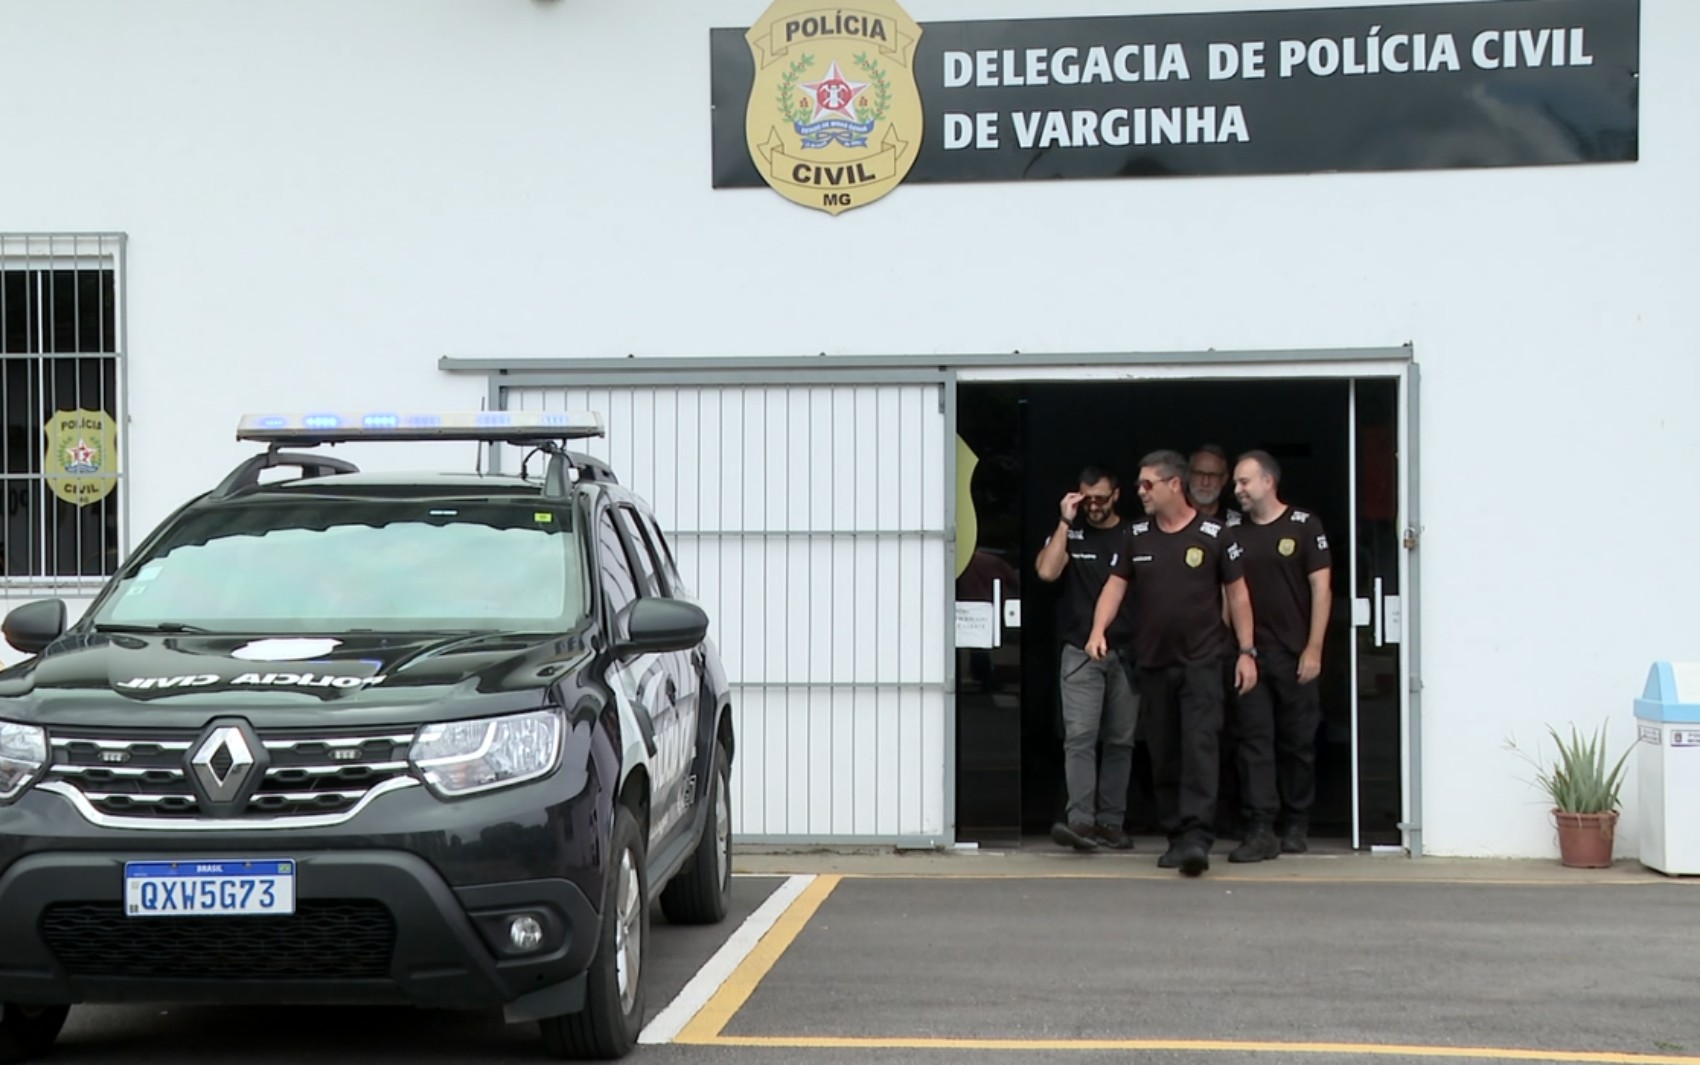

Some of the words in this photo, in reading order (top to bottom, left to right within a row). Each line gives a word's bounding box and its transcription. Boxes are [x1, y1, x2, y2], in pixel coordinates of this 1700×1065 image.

[785, 10, 887, 42] POLÍCIA
[943, 43, 1190, 88] DELEGACIA
[1208, 41, 1266, 81] DE
[1279, 26, 1461, 78] POLÍCIA
[1471, 28, 1593, 70] CIVIL
[943, 112, 1000, 150] DE
[1011, 105, 1251, 149] VARGINHA
[792, 163, 876, 186] CIVIL
[823, 193, 852, 206] MG
[141, 879, 275, 911] QXW5G73
